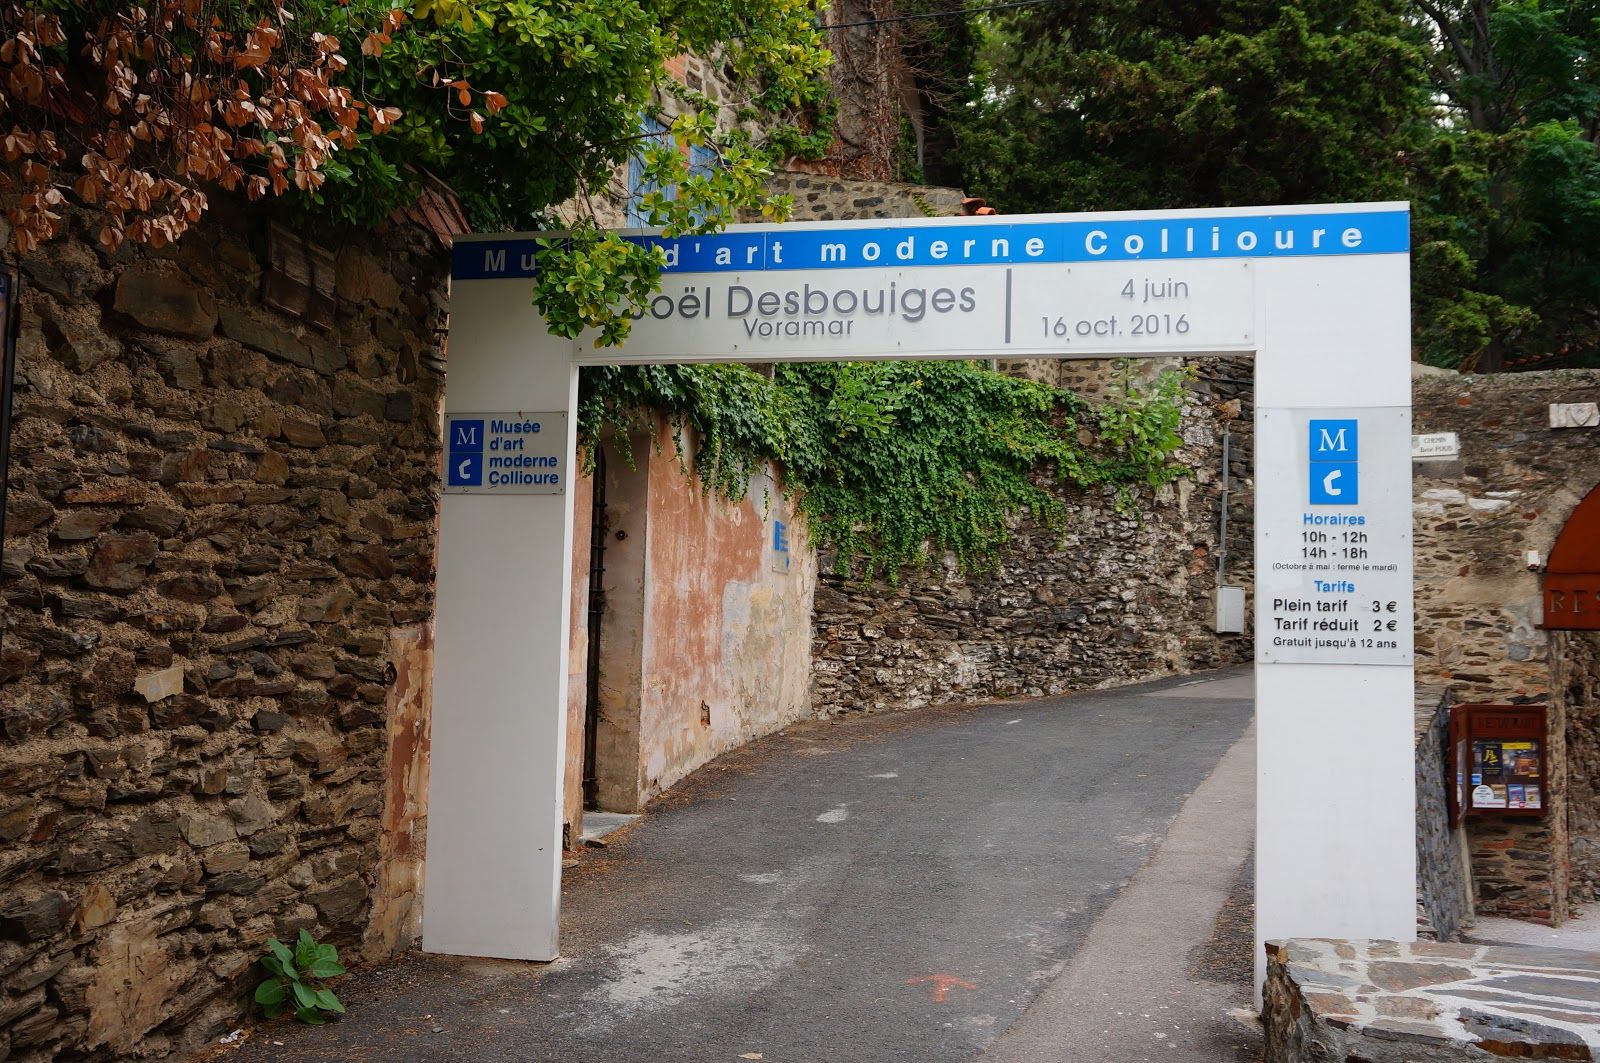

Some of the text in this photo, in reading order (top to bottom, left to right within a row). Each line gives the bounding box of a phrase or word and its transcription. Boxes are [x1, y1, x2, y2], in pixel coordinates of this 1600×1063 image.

[663, 226, 1364, 266] d'art moderne Collioure
[1120, 278, 1189, 303] 4 juin
[727, 281, 977, 322] Desbouiges
[743, 317, 854, 337] Voramar
[1041, 314, 1191, 338] 16 oct. 2016
[490, 419, 541, 434] Musée
[456, 427, 477, 445] M
[1317, 428, 1349, 452] M
[489, 437, 525, 451] d'art
[489, 454, 558, 468] moderne
[488, 470, 560, 485] Collioure
[1303, 513, 1366, 526] Horaires
[1301, 531, 1327, 543] 10h
[1342, 531, 1368, 543] 12h
[1301, 547, 1327, 559] 14h
[1342, 547, 1368, 559] 18h
[1272, 562, 1307, 571] (Octobre
[1316, 563, 1331, 571] mai
[1337, 563, 1361, 571] fermé
[1363, 563, 1370, 571] le
[1372, 563, 1398, 572] mardi)
[1314, 580, 1356, 593] Tarifs
[1273, 598, 1398, 613] Plein tarif 3 €
[1274, 617, 1398, 632] Tarif réduit 2 €
[1273, 636, 1398, 650] Gratuit jusqu'à 12 ans
